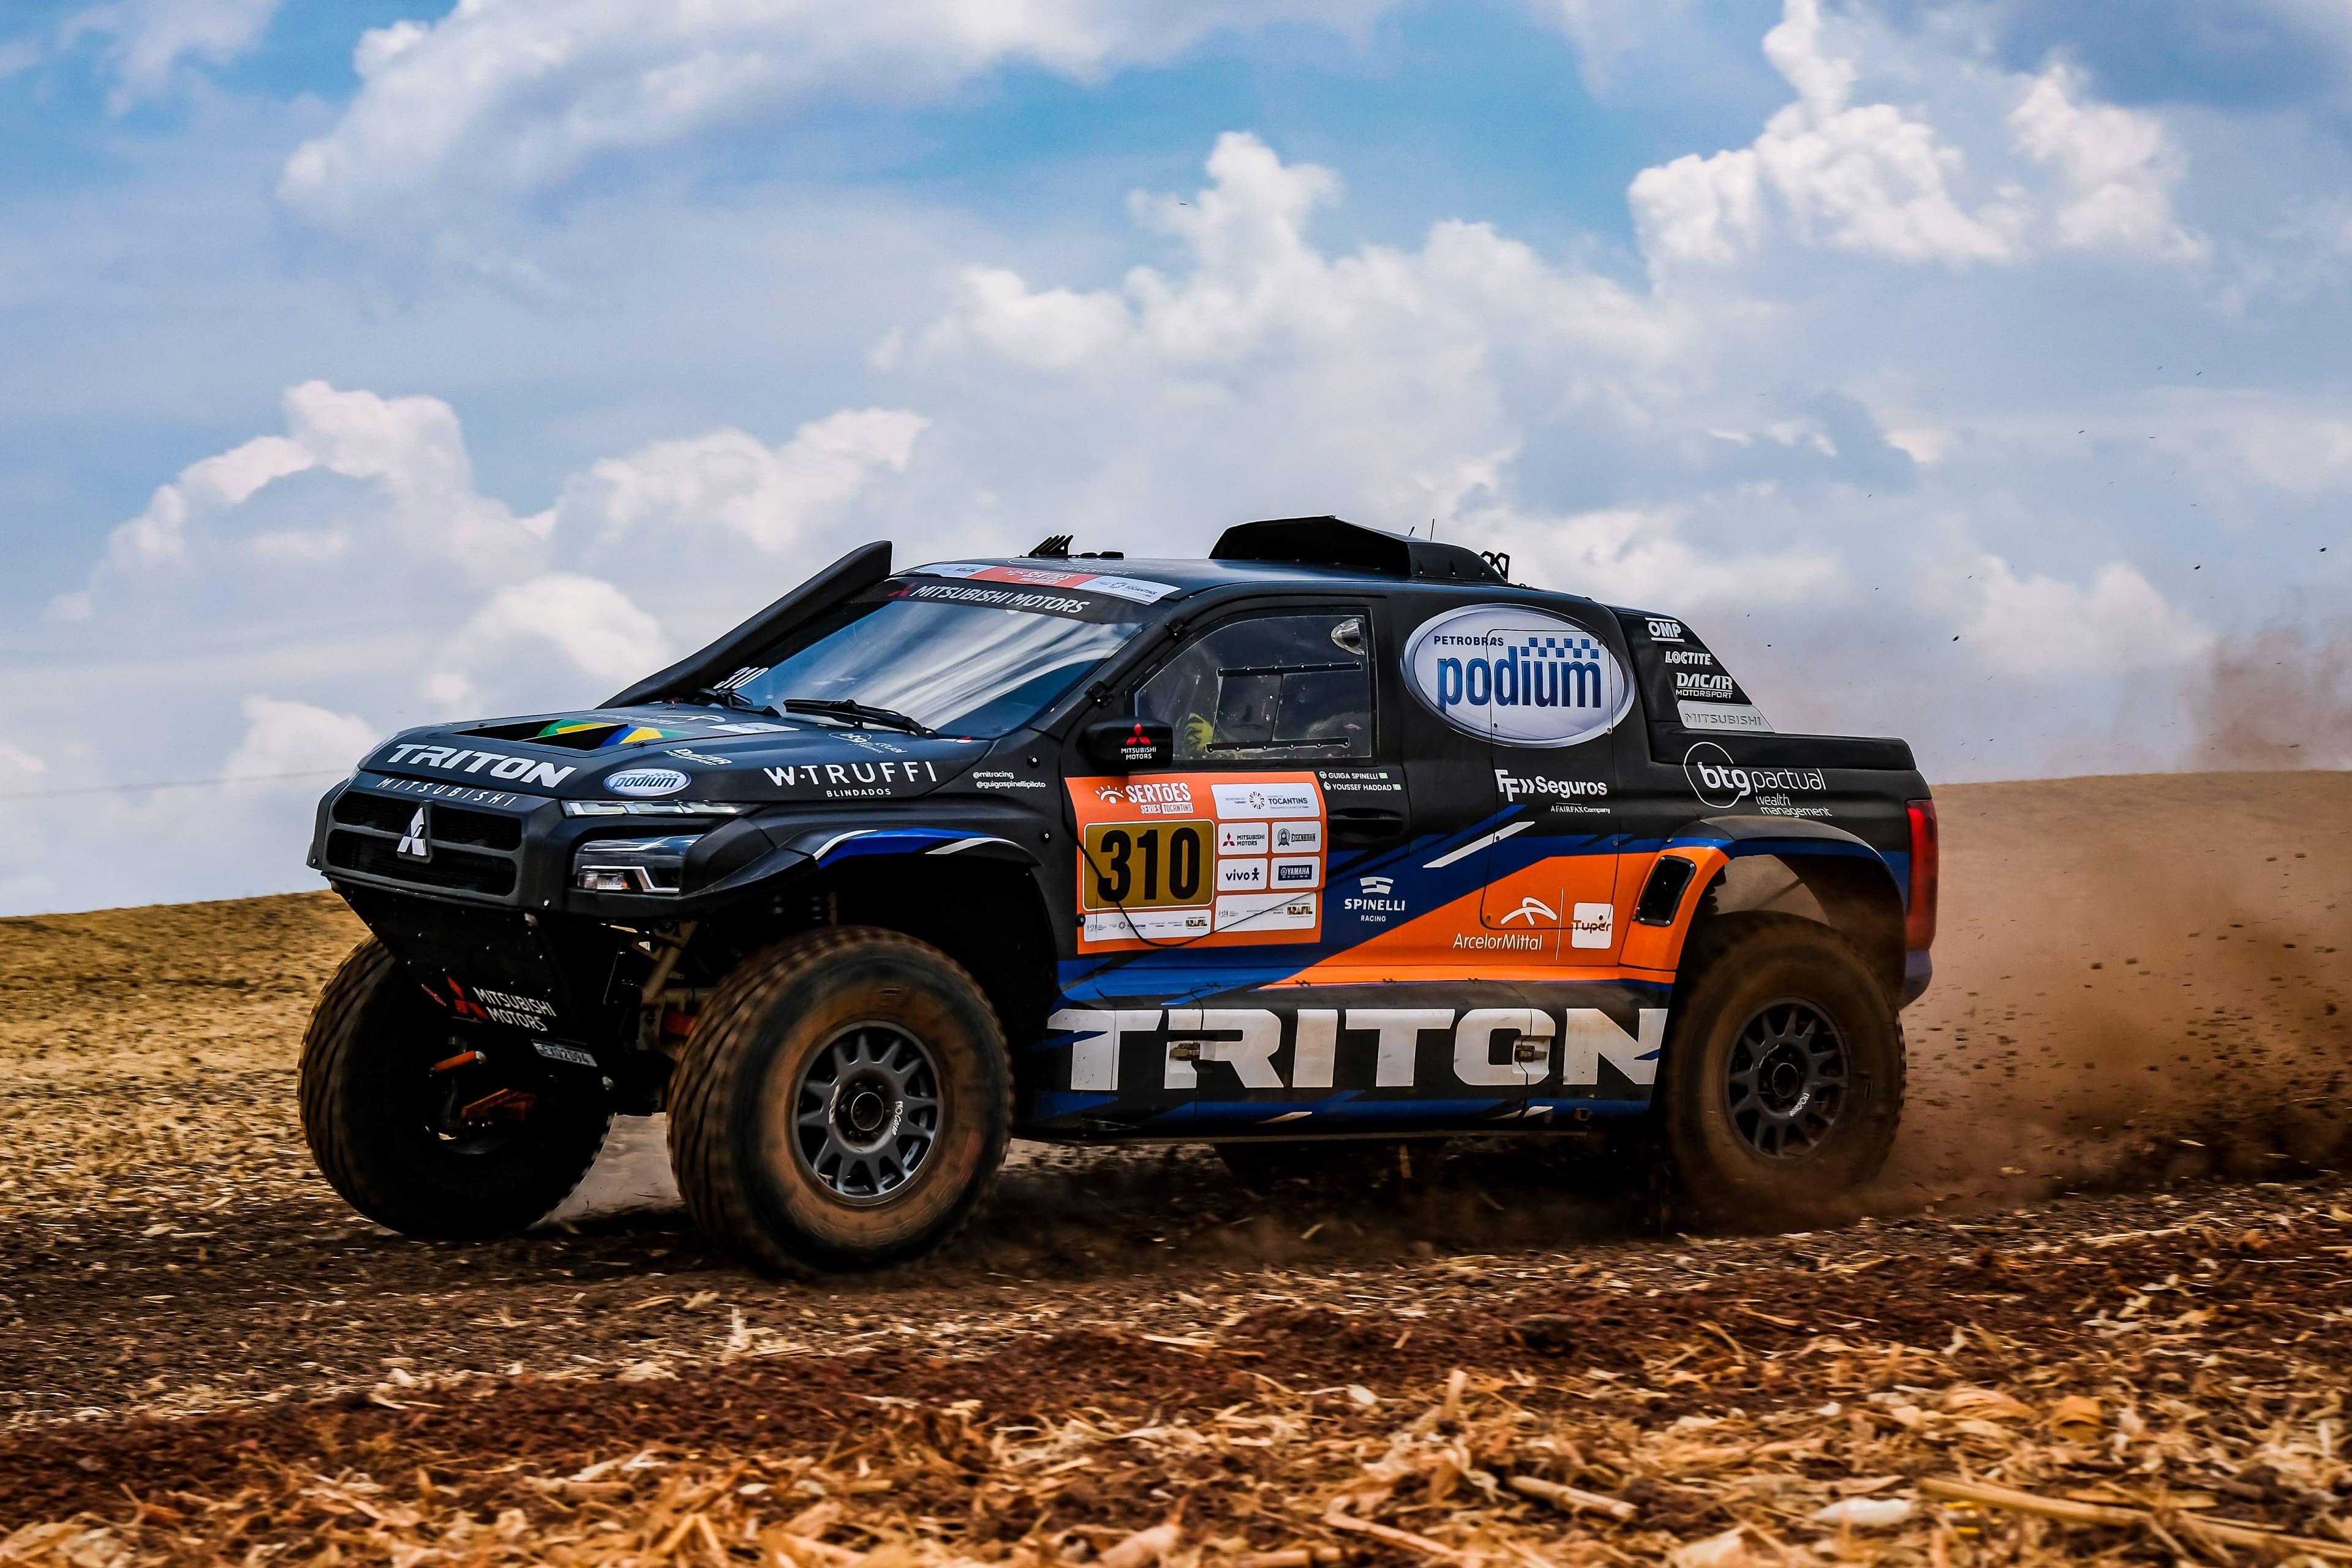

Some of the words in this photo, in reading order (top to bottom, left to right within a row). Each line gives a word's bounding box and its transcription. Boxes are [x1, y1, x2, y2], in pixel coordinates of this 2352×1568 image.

[910, 585, 1011, 605] MITSUBISHI
[1006, 593, 1090, 613] MOTORS
[1648, 622, 1681, 638] OMP
[1433, 635, 1504, 647] PETROBRAS
[1665, 651, 1713, 665] LOCTITE
[1437, 646, 1601, 713] podium
[1676, 673, 1733, 690] DACAR
[1676, 690, 1733, 699] MOTORSPORT
[1684, 712, 1762, 726] MITSUBISHI
[386, 743, 578, 788] TRITON
[613, 775, 677, 789] podium
[1697, 761, 1751, 796] btg
[1751, 768, 1827, 793] pactual
[376, 778, 517, 807] MITSUBISHI
[826, 788, 892, 797] BLINDADOS
[1535, 776, 1608, 799] Seguros
[1756, 793, 1790, 807] wealth
[1140, 804, 1161, 813] SERIES
[1163, 804, 1193, 813] TOCANTINS
[1760, 806, 1833, 818] management
[1099, 827, 1201, 903] 310
[1287, 867, 1310, 875] YAMAHA
[1226, 869, 1251, 881] vivo
[1344, 898, 1406, 911] SPINELLI
[1571, 919, 1611, 934] Tuper
[1452, 933, 1544, 951] ArcelorMittal
[472, 987, 557, 1017] MITSUBISHI
[486, 1006, 548, 1031] MOTORS
[1047, 1008, 1668, 1091] TRITON
